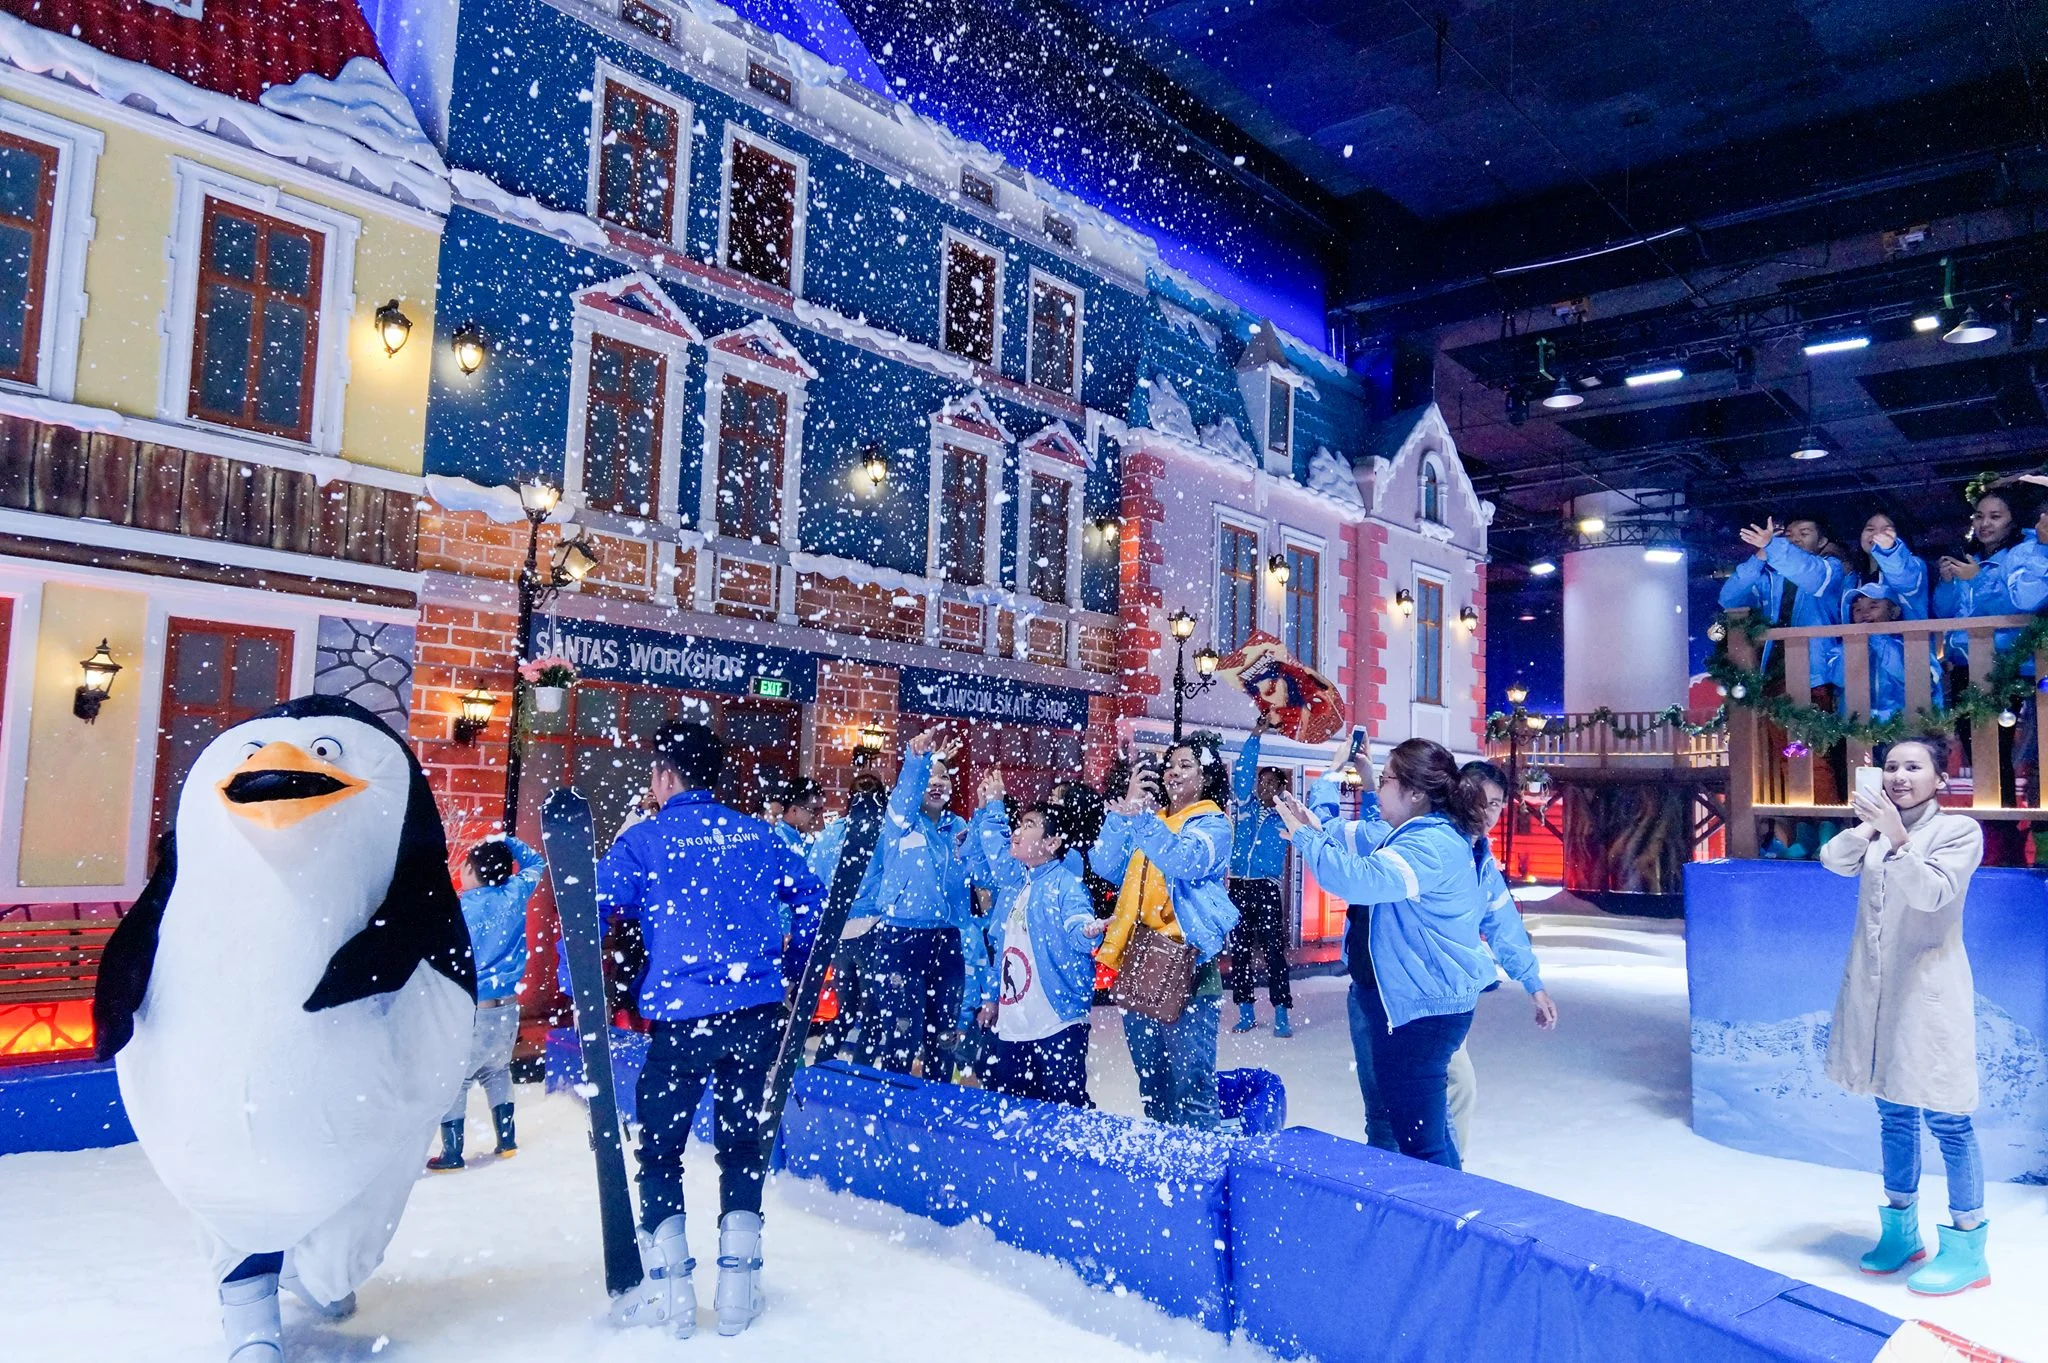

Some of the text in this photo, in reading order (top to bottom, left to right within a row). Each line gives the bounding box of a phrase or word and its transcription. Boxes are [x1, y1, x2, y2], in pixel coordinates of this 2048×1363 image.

[535, 631, 743, 682] SANTA'S WORKSHOP
[760, 680, 782, 696] EXIT
[996, 693, 1033, 718] SKATE
[1036, 698, 1069, 721] SHOP
[677, 832, 760, 848] SNOW TOWN
